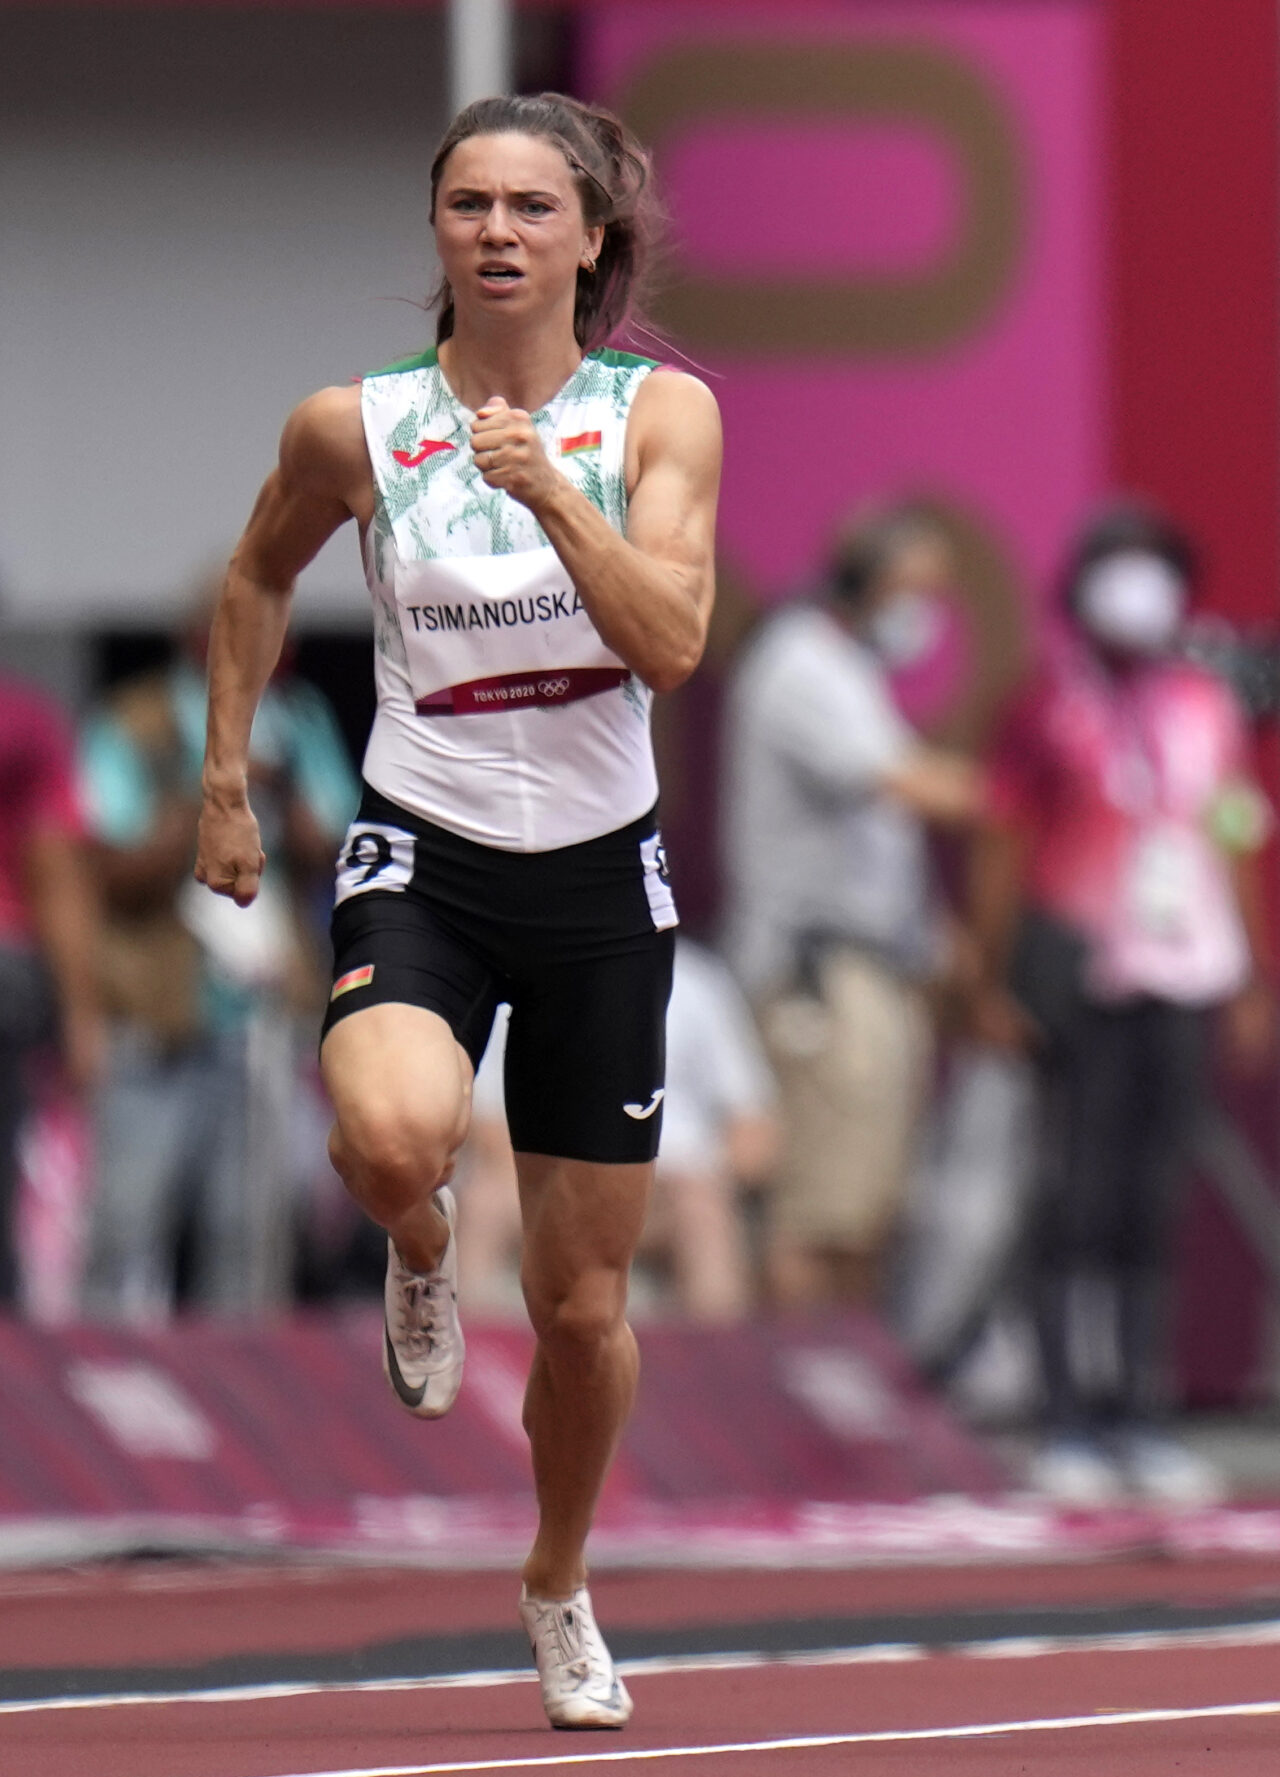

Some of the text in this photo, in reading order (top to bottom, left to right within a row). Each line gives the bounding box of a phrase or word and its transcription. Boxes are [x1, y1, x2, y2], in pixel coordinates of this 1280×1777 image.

[473, 685, 535, 702] TOKYO 2020
[346, 832, 393, 887] 9
